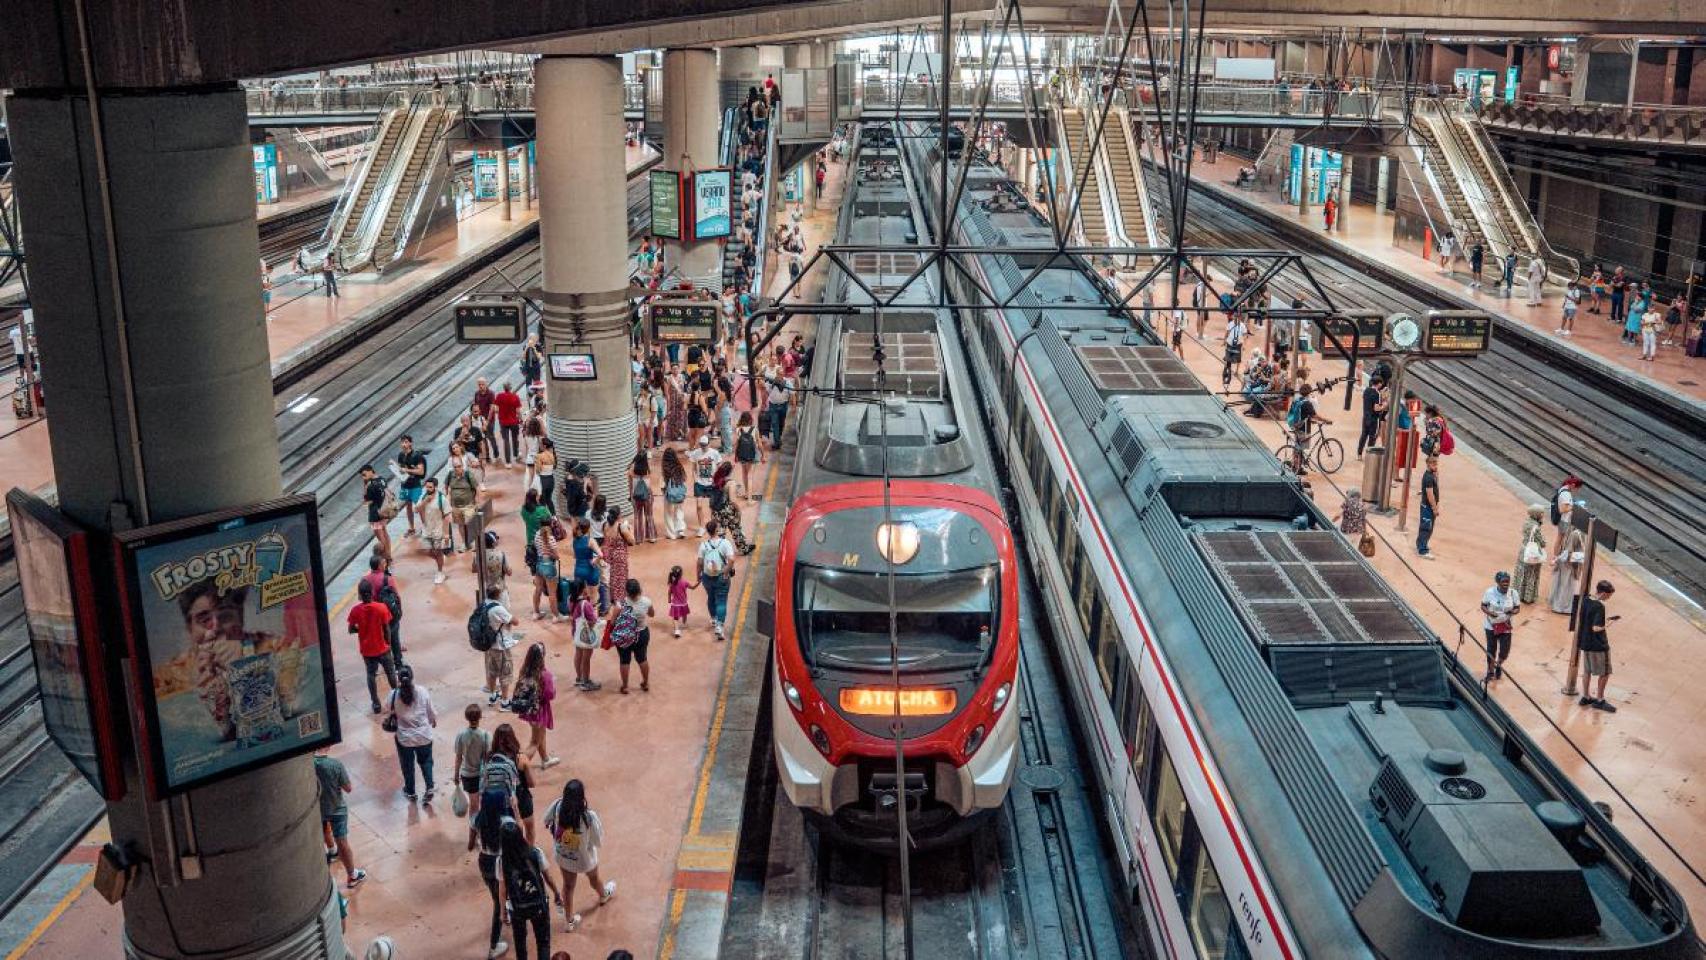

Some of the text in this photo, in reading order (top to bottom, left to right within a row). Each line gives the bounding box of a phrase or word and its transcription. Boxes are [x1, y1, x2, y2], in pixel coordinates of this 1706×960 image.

[155, 542, 253, 599] FROSTY
[842, 553, 860, 567] M
[1239, 892, 1262, 944] renfe
